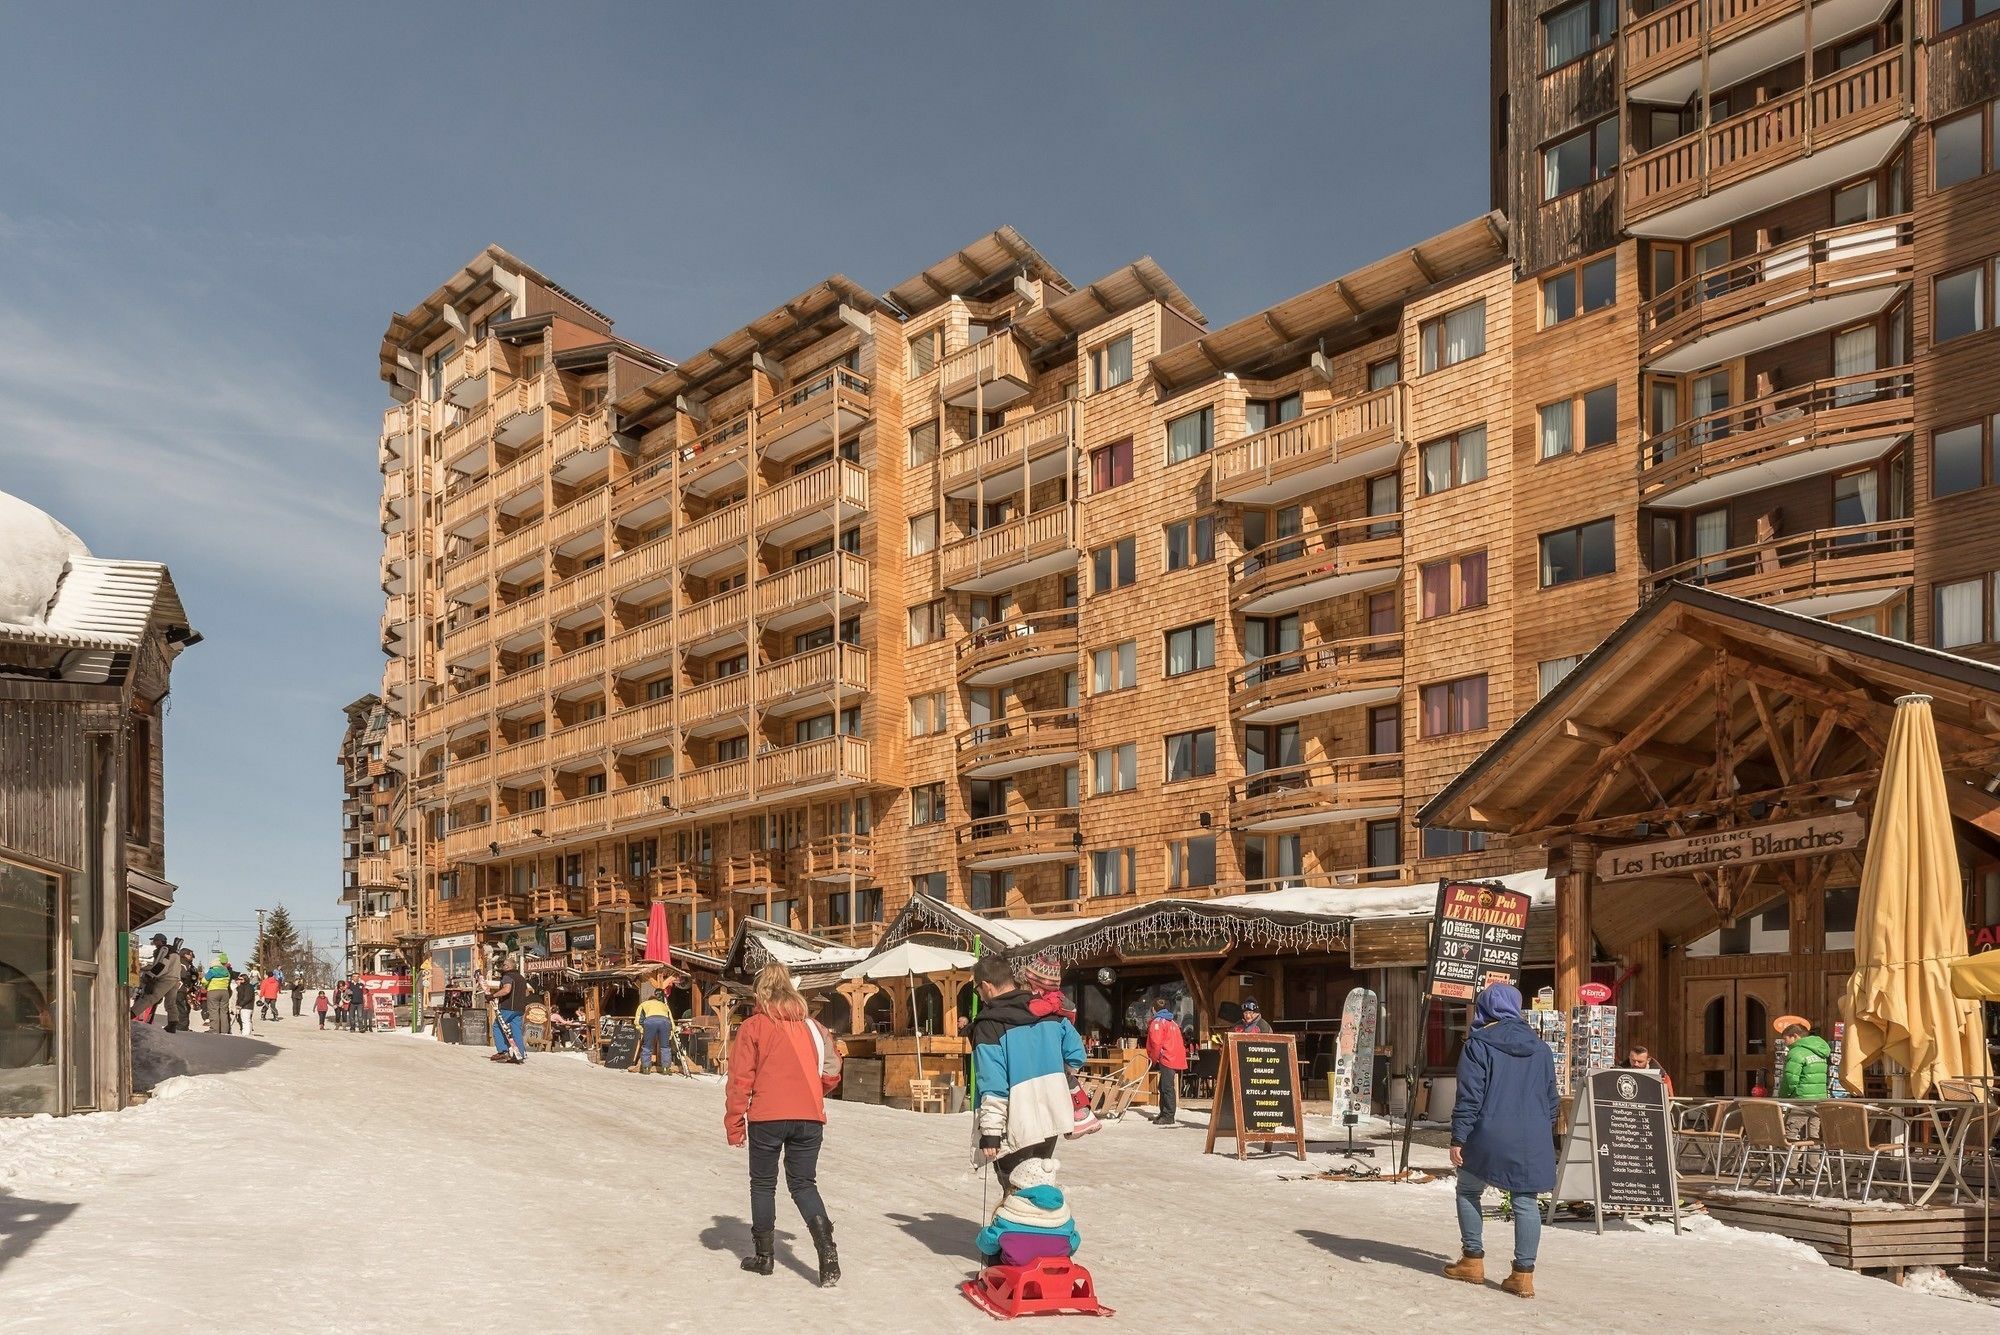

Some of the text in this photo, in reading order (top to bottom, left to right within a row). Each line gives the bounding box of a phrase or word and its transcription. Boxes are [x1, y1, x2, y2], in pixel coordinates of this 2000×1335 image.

[1688, 831, 1752, 847] RESIDENCE
[1613, 826, 1844, 876] Les Fontaines Blanches
[1454, 889, 1517, 910] Bar Pub
[1445, 904, 1524, 928] LE TAVAILLON
[1442, 920, 1454, 936] 10
[1454, 926, 1480, 935] BEERS
[1485, 927, 1495, 942] 4
[1496, 932, 1522, 942] SPORT
[1444, 941, 1458, 957] 30
[1484, 948, 1518, 962] TAPAS
[527, 959, 565, 970] RESTAURANT
[1435, 960, 1448, 976] 12
[1448, 966, 1474, 975] SNACK
[361, 980, 397, 990] SF
[1440, 982, 1466, 991] BIENVENUE
